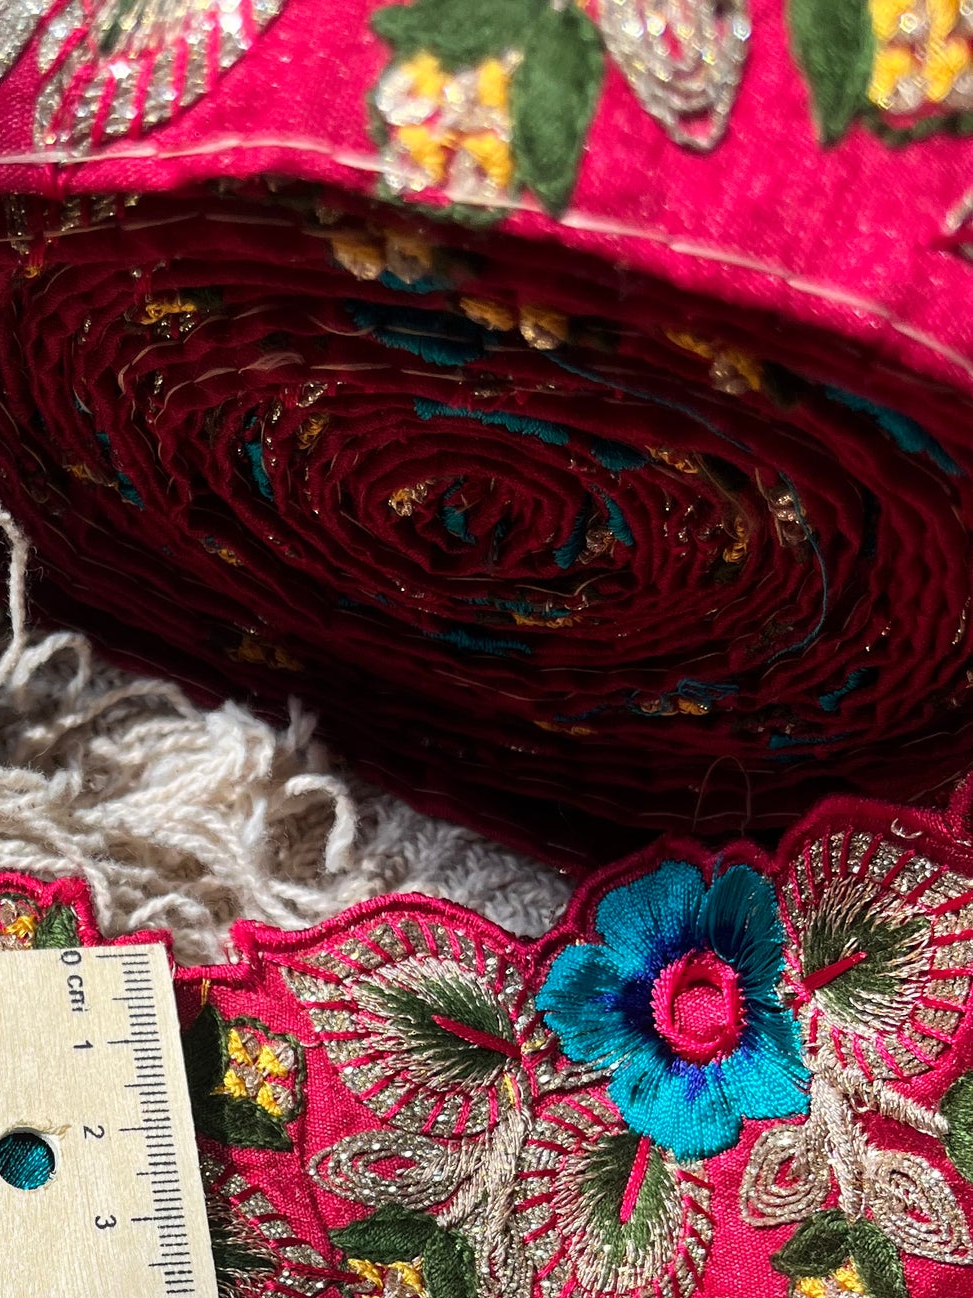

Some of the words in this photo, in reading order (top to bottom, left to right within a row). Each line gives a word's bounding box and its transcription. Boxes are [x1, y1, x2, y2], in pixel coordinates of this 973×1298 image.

[60, 950, 82, 966] 0
[66, 974, 88, 1012] cm
[73, 1039, 94, 1050] 1
[82, 1125, 105, 1140] 2
[94, 1214, 117, 1230] 3
